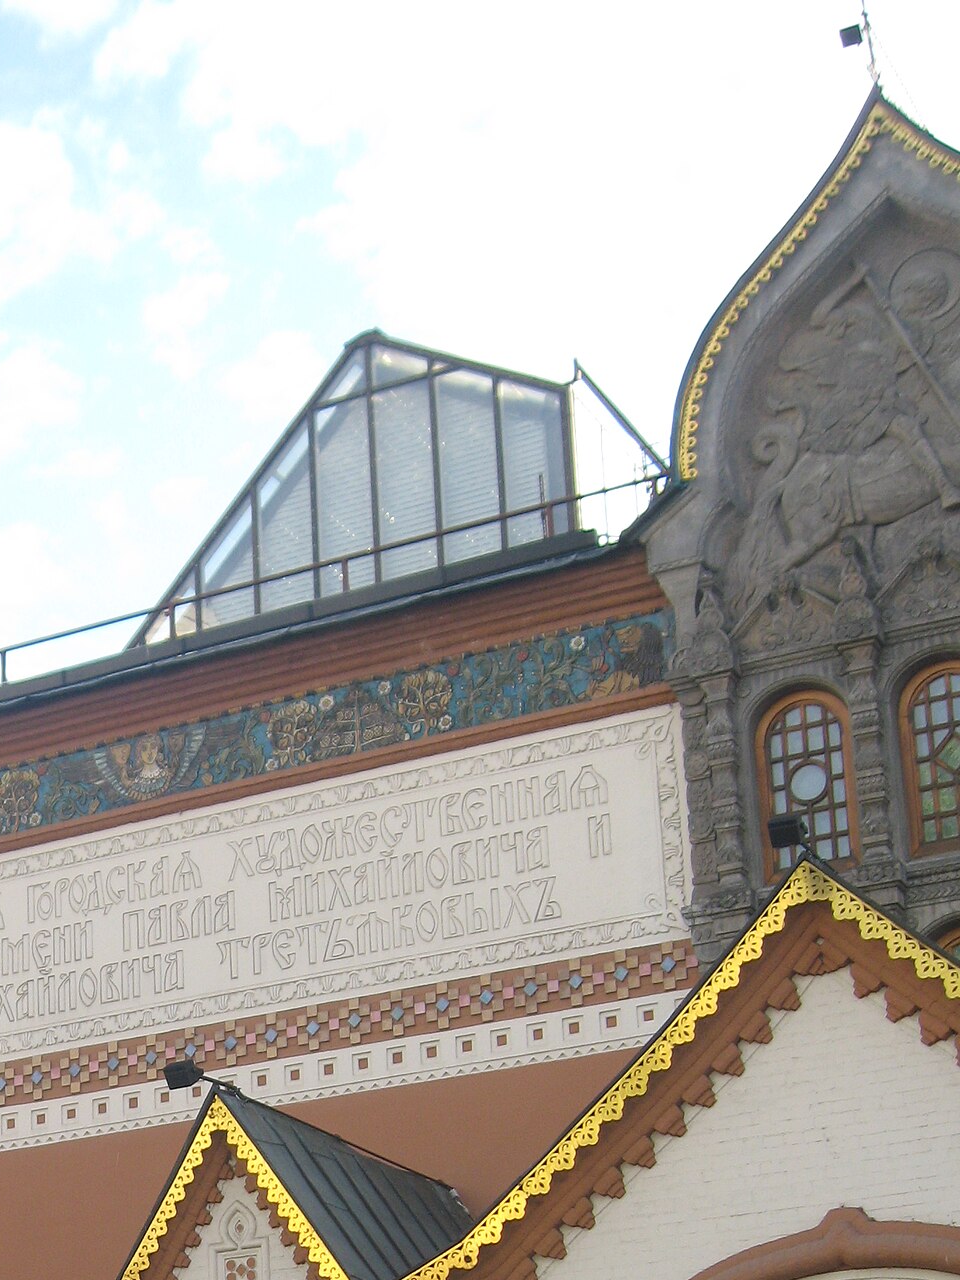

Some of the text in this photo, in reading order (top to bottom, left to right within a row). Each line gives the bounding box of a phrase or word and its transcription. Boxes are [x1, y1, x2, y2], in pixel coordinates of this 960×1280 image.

[122, 890, 235, 952] ПАВЛА
[268, 825, 550, 922] МИХАЙЛОВИЧА
[587, 813, 612, 858] И
